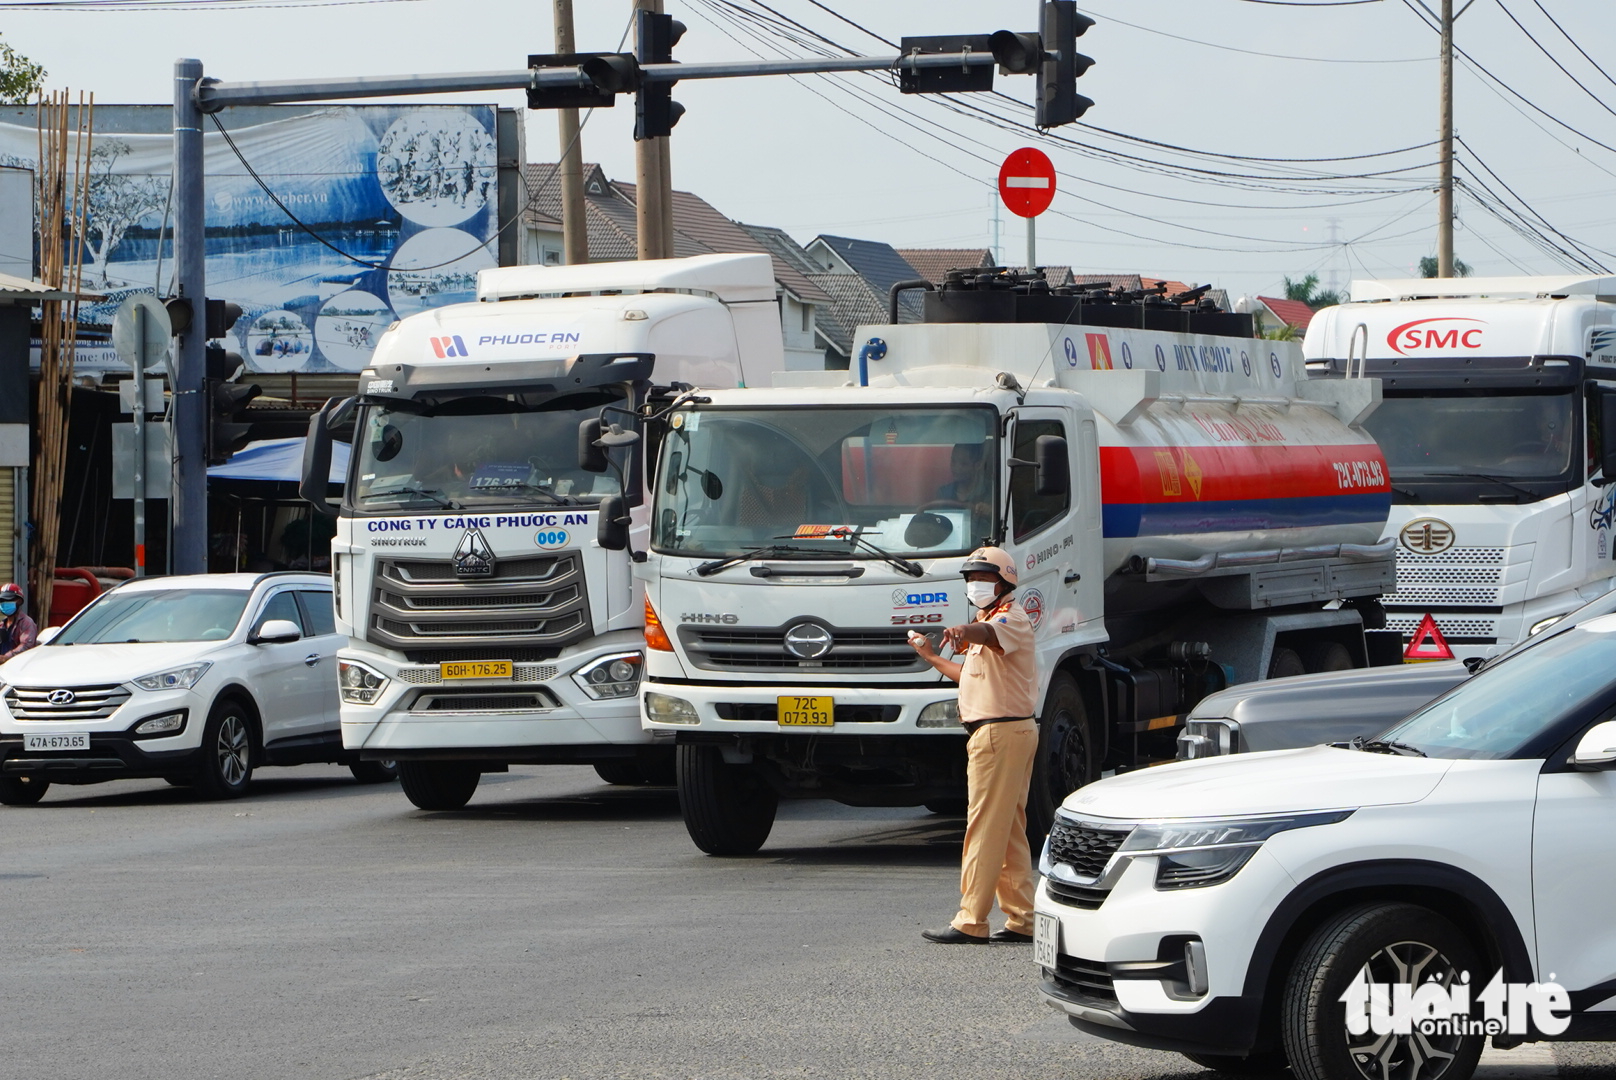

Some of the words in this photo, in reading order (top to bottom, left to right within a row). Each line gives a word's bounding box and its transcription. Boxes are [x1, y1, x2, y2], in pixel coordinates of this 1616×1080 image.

[478, 333, 547, 346] PHUOC
[550, 332, 580, 343] AN
[1403, 329, 1483, 349] SMC
[367, 516, 412, 532] CÔNG
[416, 519, 438, 529] TY
[563, 514, 589, 525] AN
[370, 536, 428, 547] SINOTRUK
[537, 531, 567, 545] 009
[1036, 543, 1060, 564] HINO
[906, 592, 949, 605] QDR
[680, 613, 740, 625] HINO
[446, 664, 507, 676] 60H-176.25
[793, 697, 818, 710] 72C
[784, 711, 828, 724] 073.93
[30, 736, 85, 748] 47A-673.65
[1040, 916, 1051, 940] 51K
